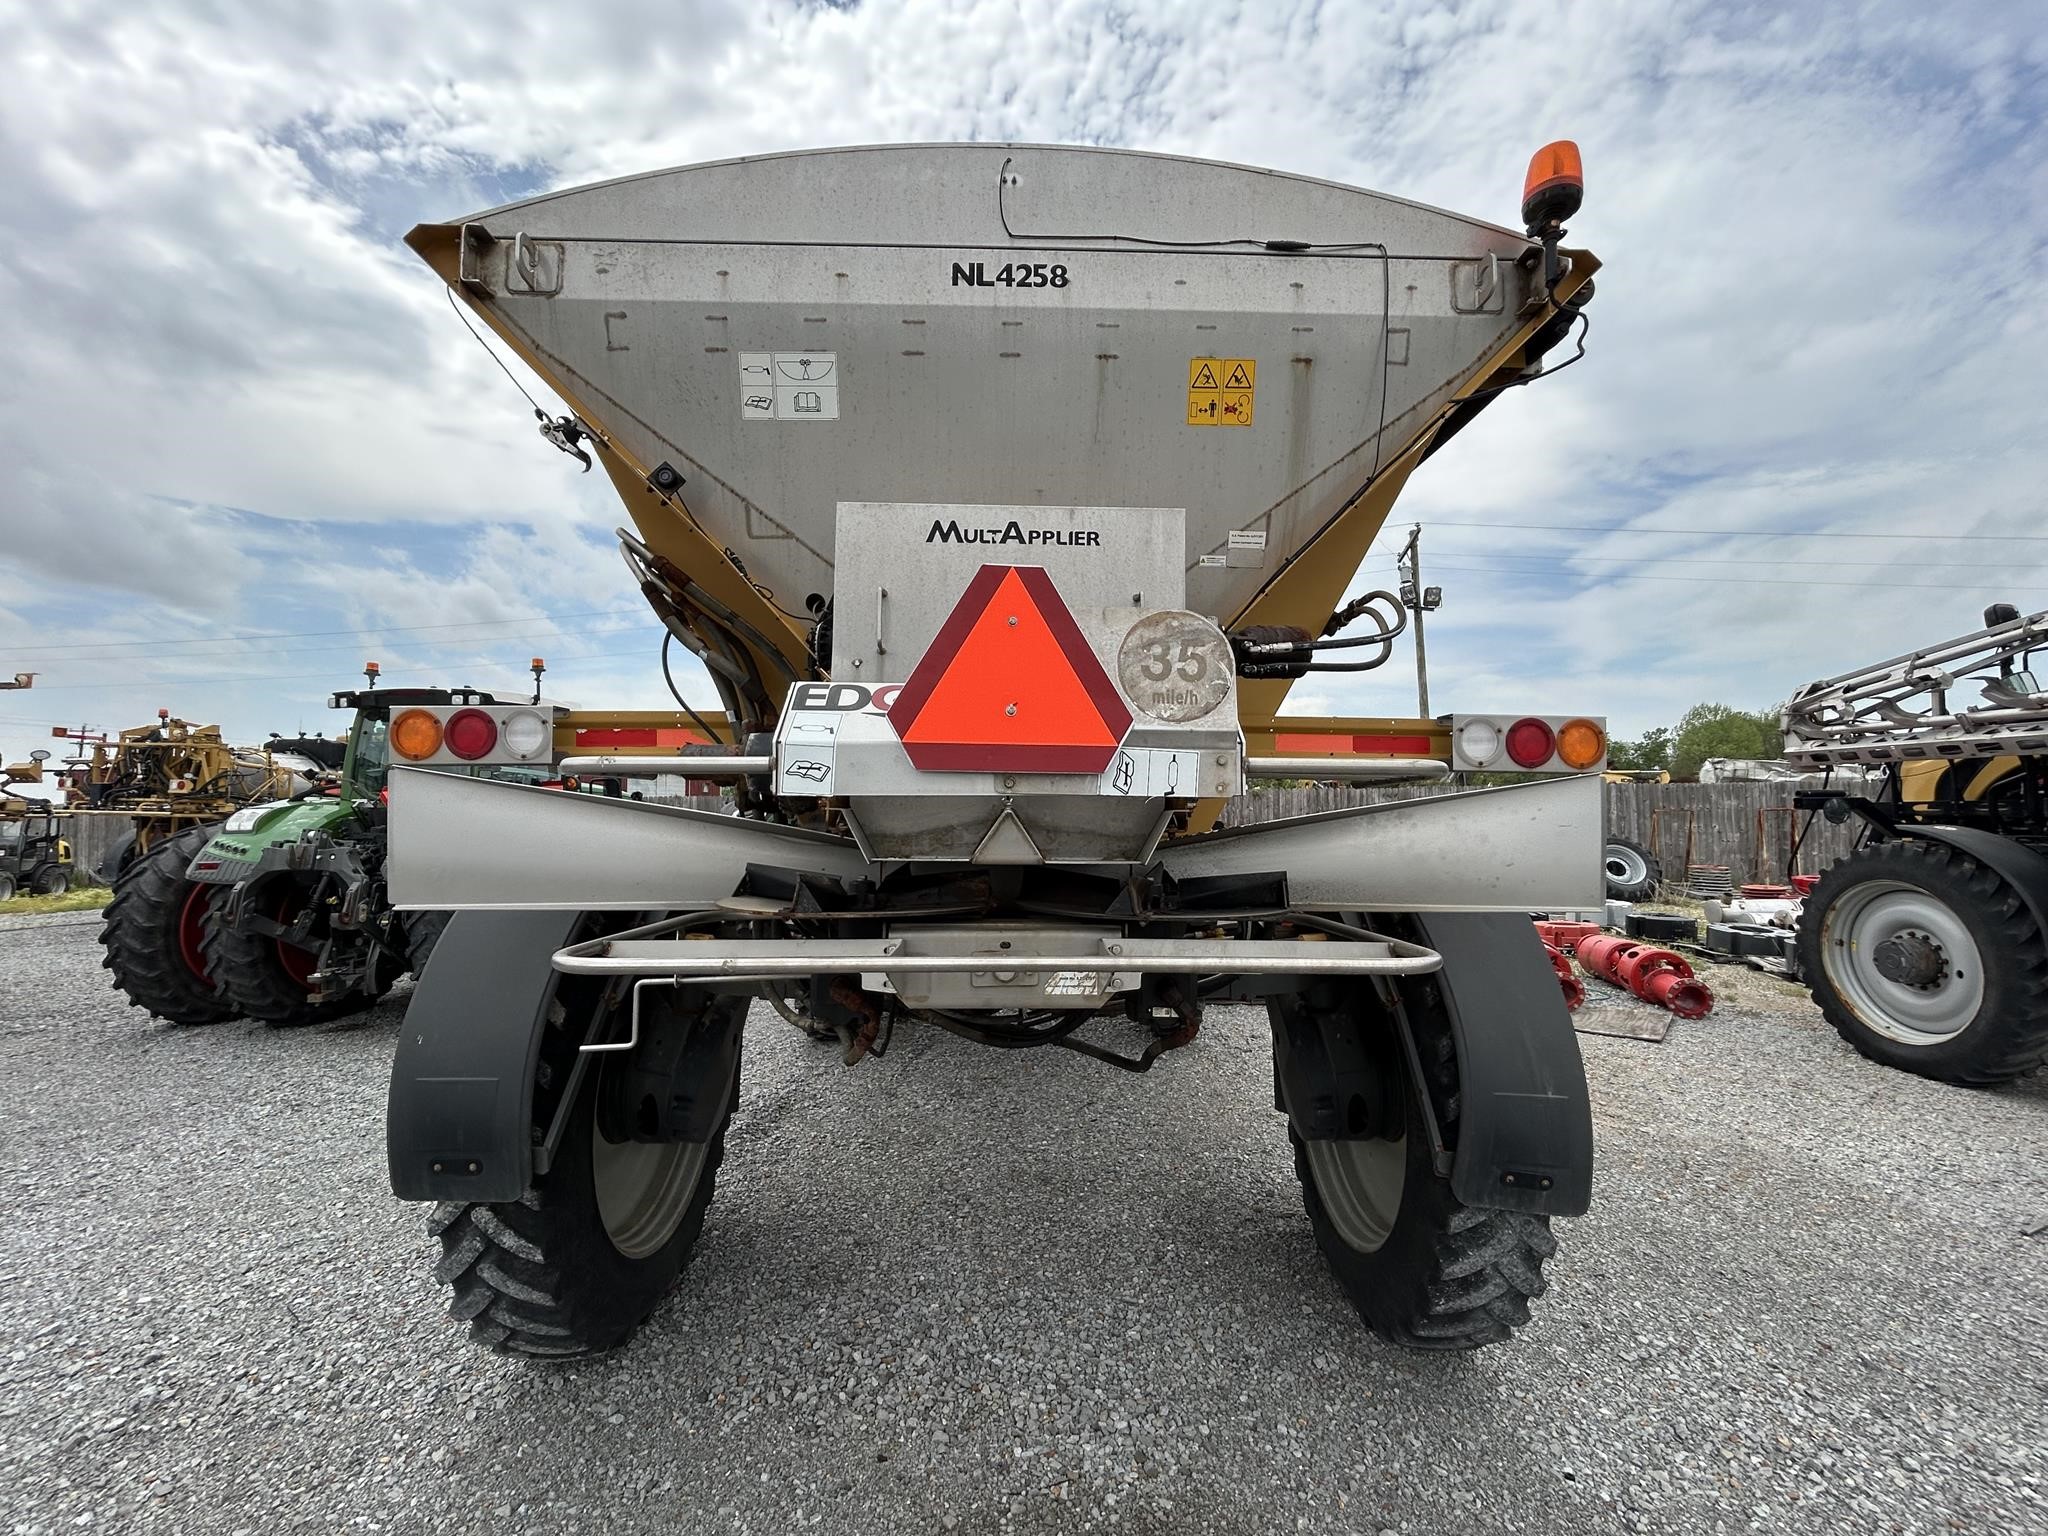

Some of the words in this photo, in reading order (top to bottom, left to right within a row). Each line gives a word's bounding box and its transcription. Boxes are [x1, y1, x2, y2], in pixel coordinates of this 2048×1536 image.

[952, 262, 1069, 288] NL4258
[1141, 639, 1207, 683] 35
[1152, 689, 1198, 705] mile/h
